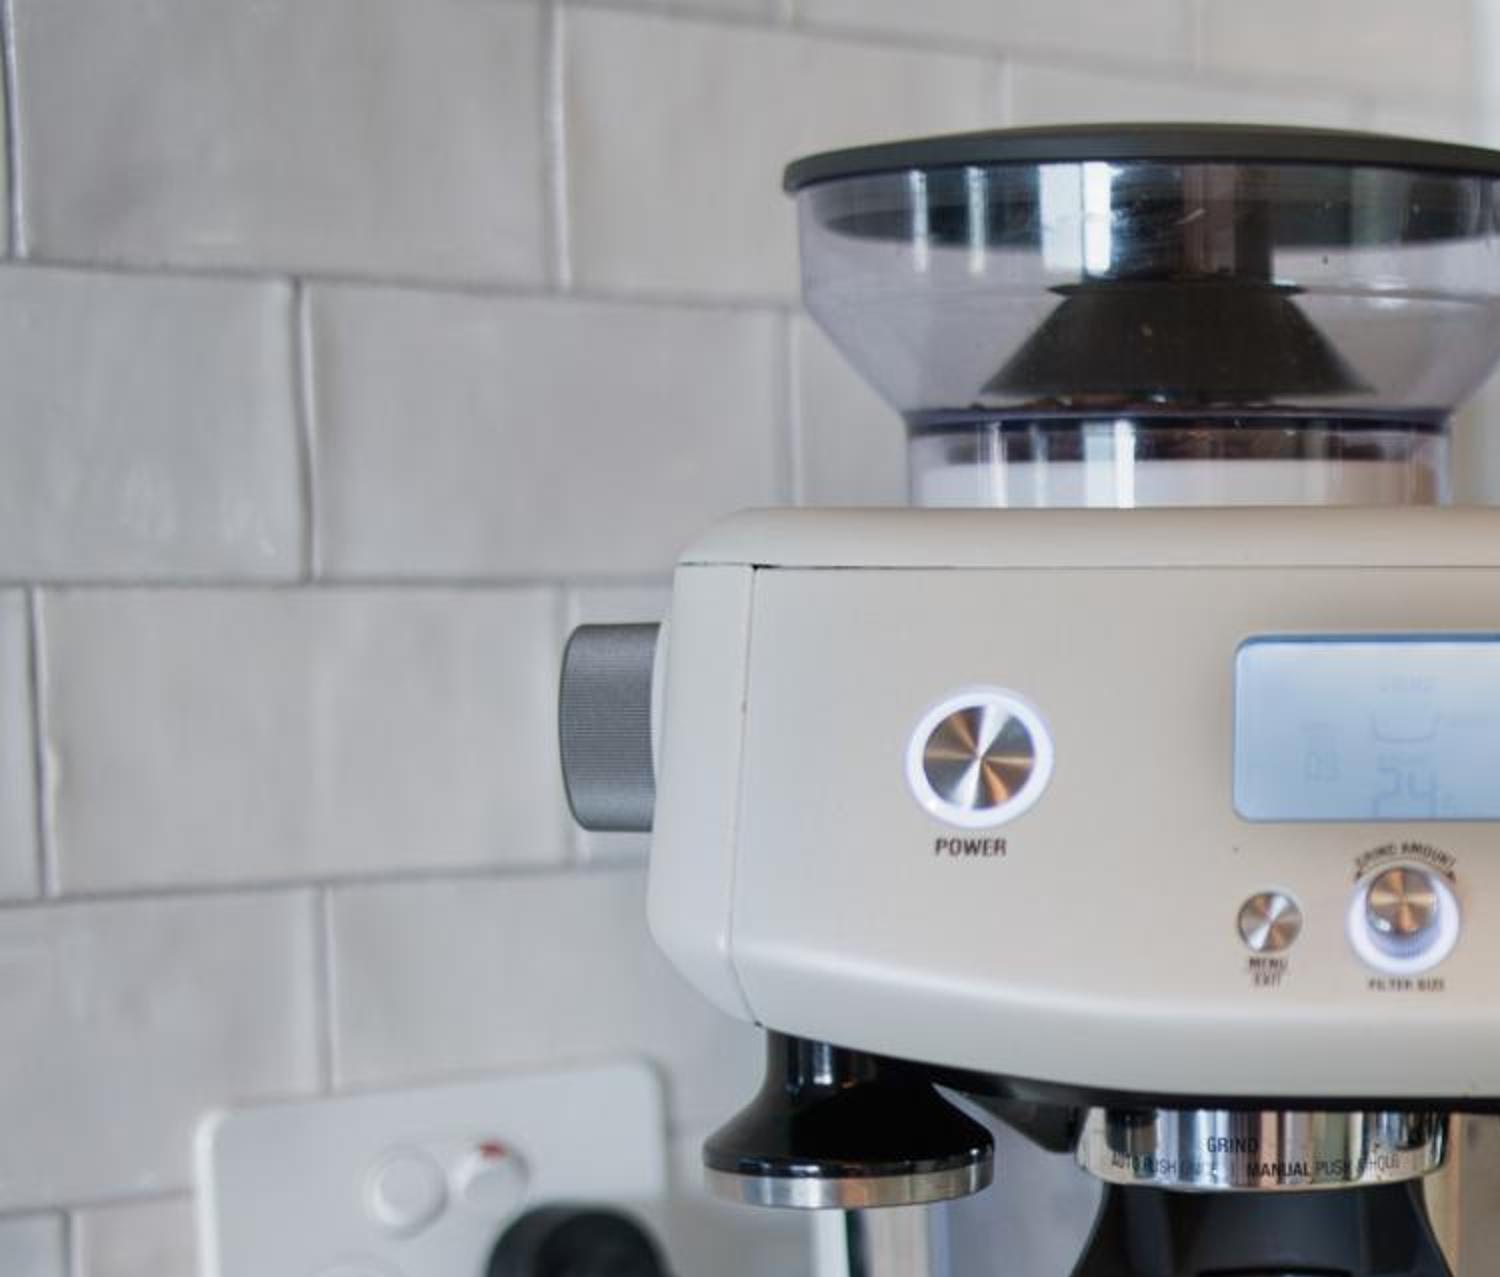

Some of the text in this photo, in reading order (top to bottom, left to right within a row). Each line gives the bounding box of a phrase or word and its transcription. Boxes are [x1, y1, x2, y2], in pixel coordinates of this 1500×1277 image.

[934, 837, 1008, 857] POWER
[1401, 841, 1457, 867] AMOUNT
[1368, 977, 1413, 992] FILTER
[1206, 1136, 1259, 1154] GRIND
[1246, 1160, 1311, 1178] MANUAL
